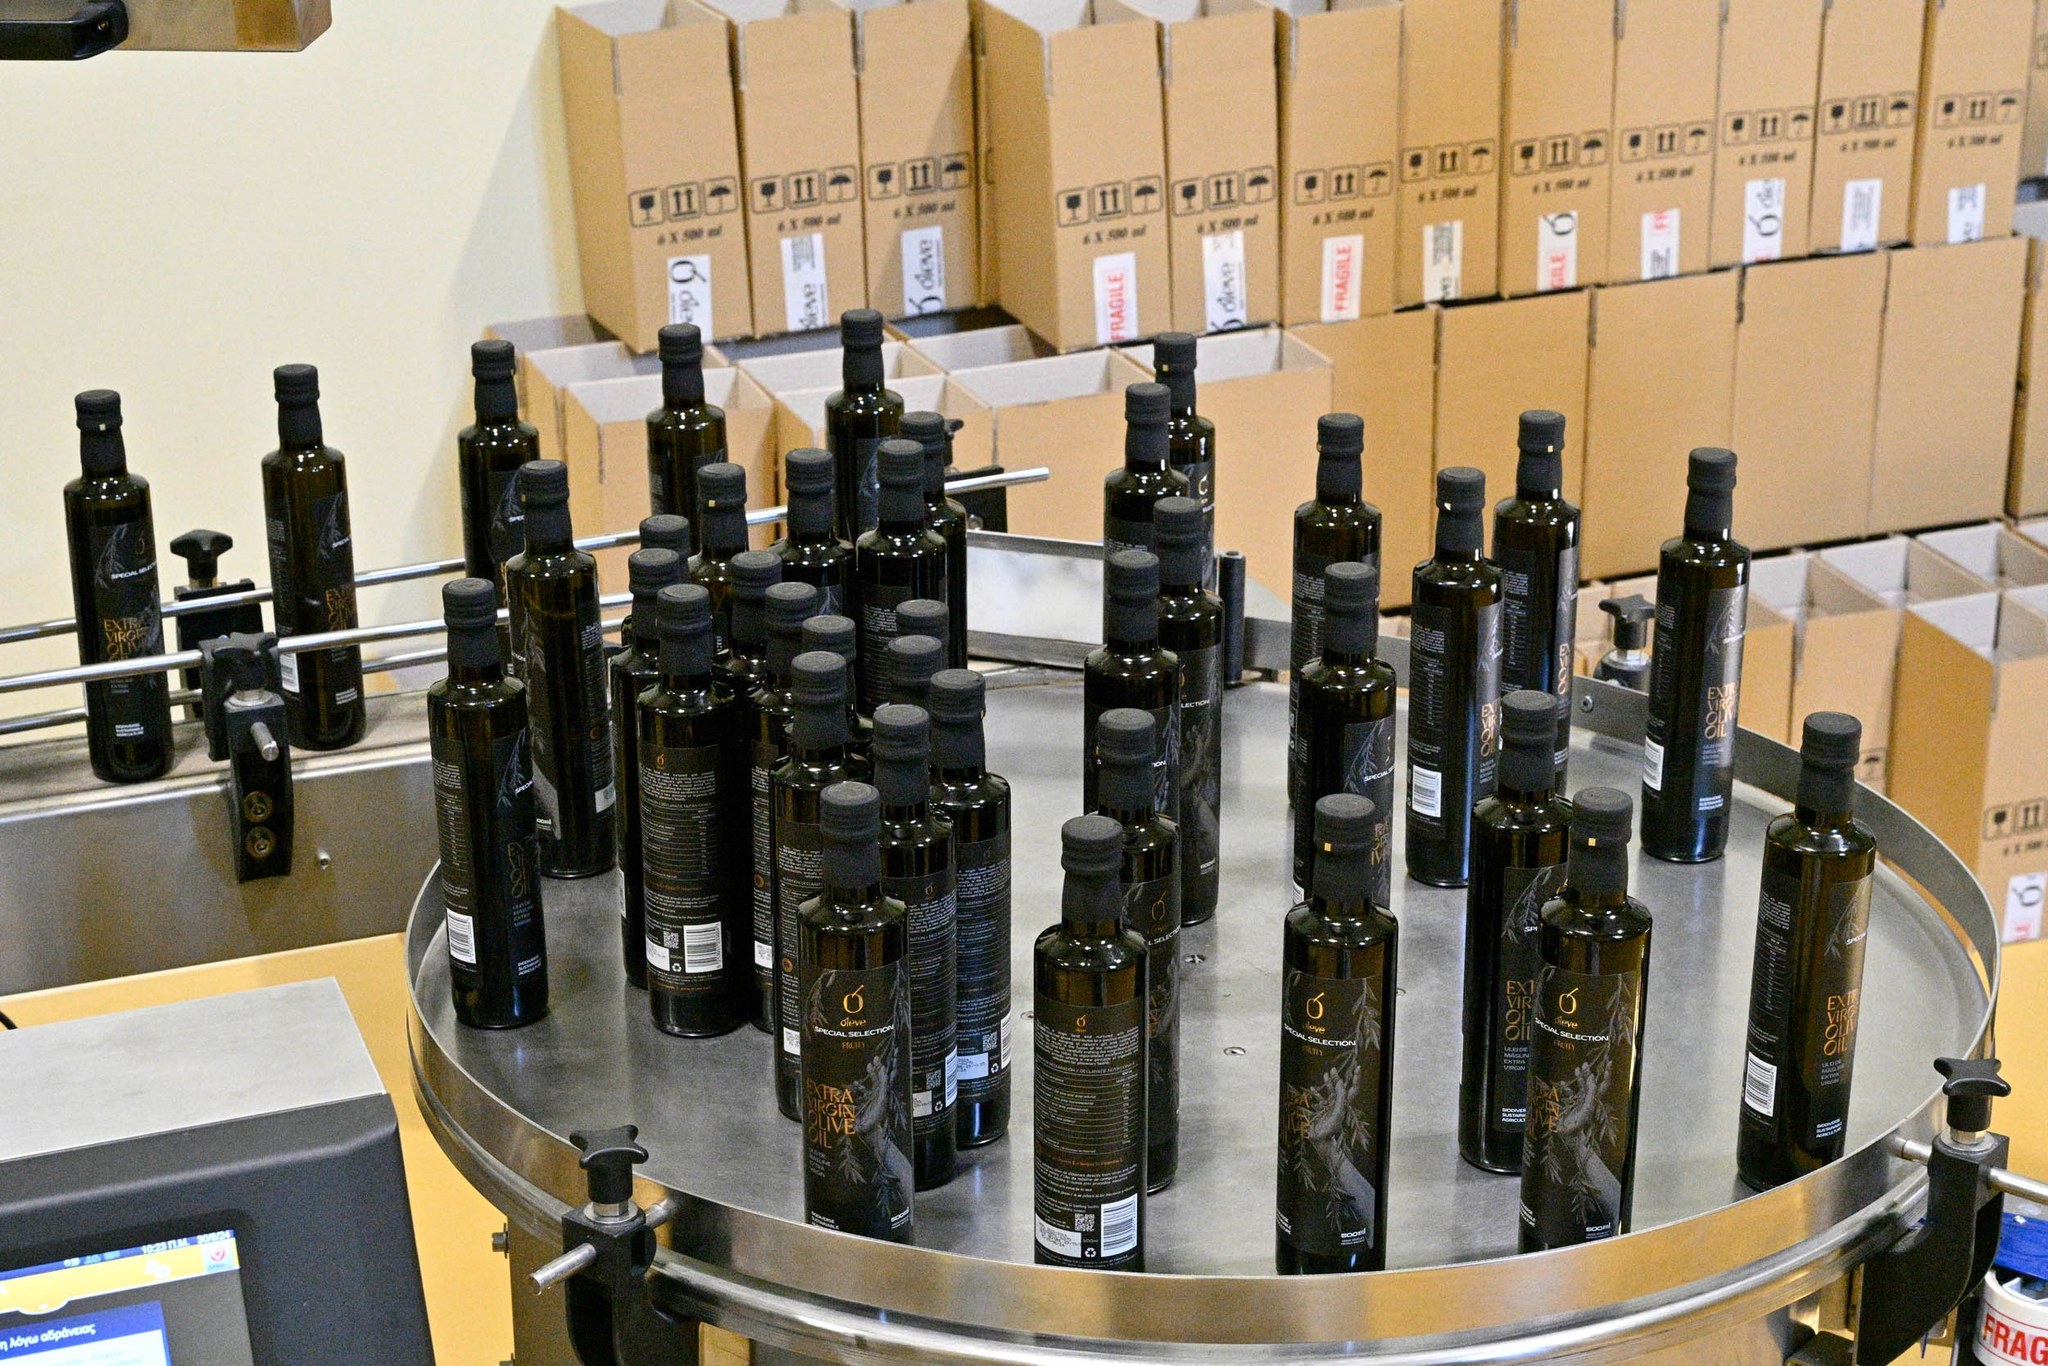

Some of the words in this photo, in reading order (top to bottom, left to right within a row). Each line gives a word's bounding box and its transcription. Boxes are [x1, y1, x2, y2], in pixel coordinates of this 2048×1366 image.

[708, 225, 723, 238] ml
[1132, 225, 1146, 238] ml
[1335, 246, 1351, 312] FRAGILE
[1110, 273, 1125, 341] FRAGILE
[814, 1026, 847, 1038] SPECIAL
[848, 1024, 895, 1038] SELECTION
[1283, 1023, 1307, 1041] SPECIAL
[1307, 1035, 1356, 1047] SELECTION
[1535, 1017, 1560, 1036] SPECIAL
[1560, 1030, 1609, 1042] SELECTION
[1823, 1036, 1848, 1056] OIL
[807, 1078, 854, 1104] EXTRA
[808, 1097, 856, 1118] VIRGIN
[809, 1109, 856, 1136] OLIVE
[809, 1126, 833, 1150] OIL
